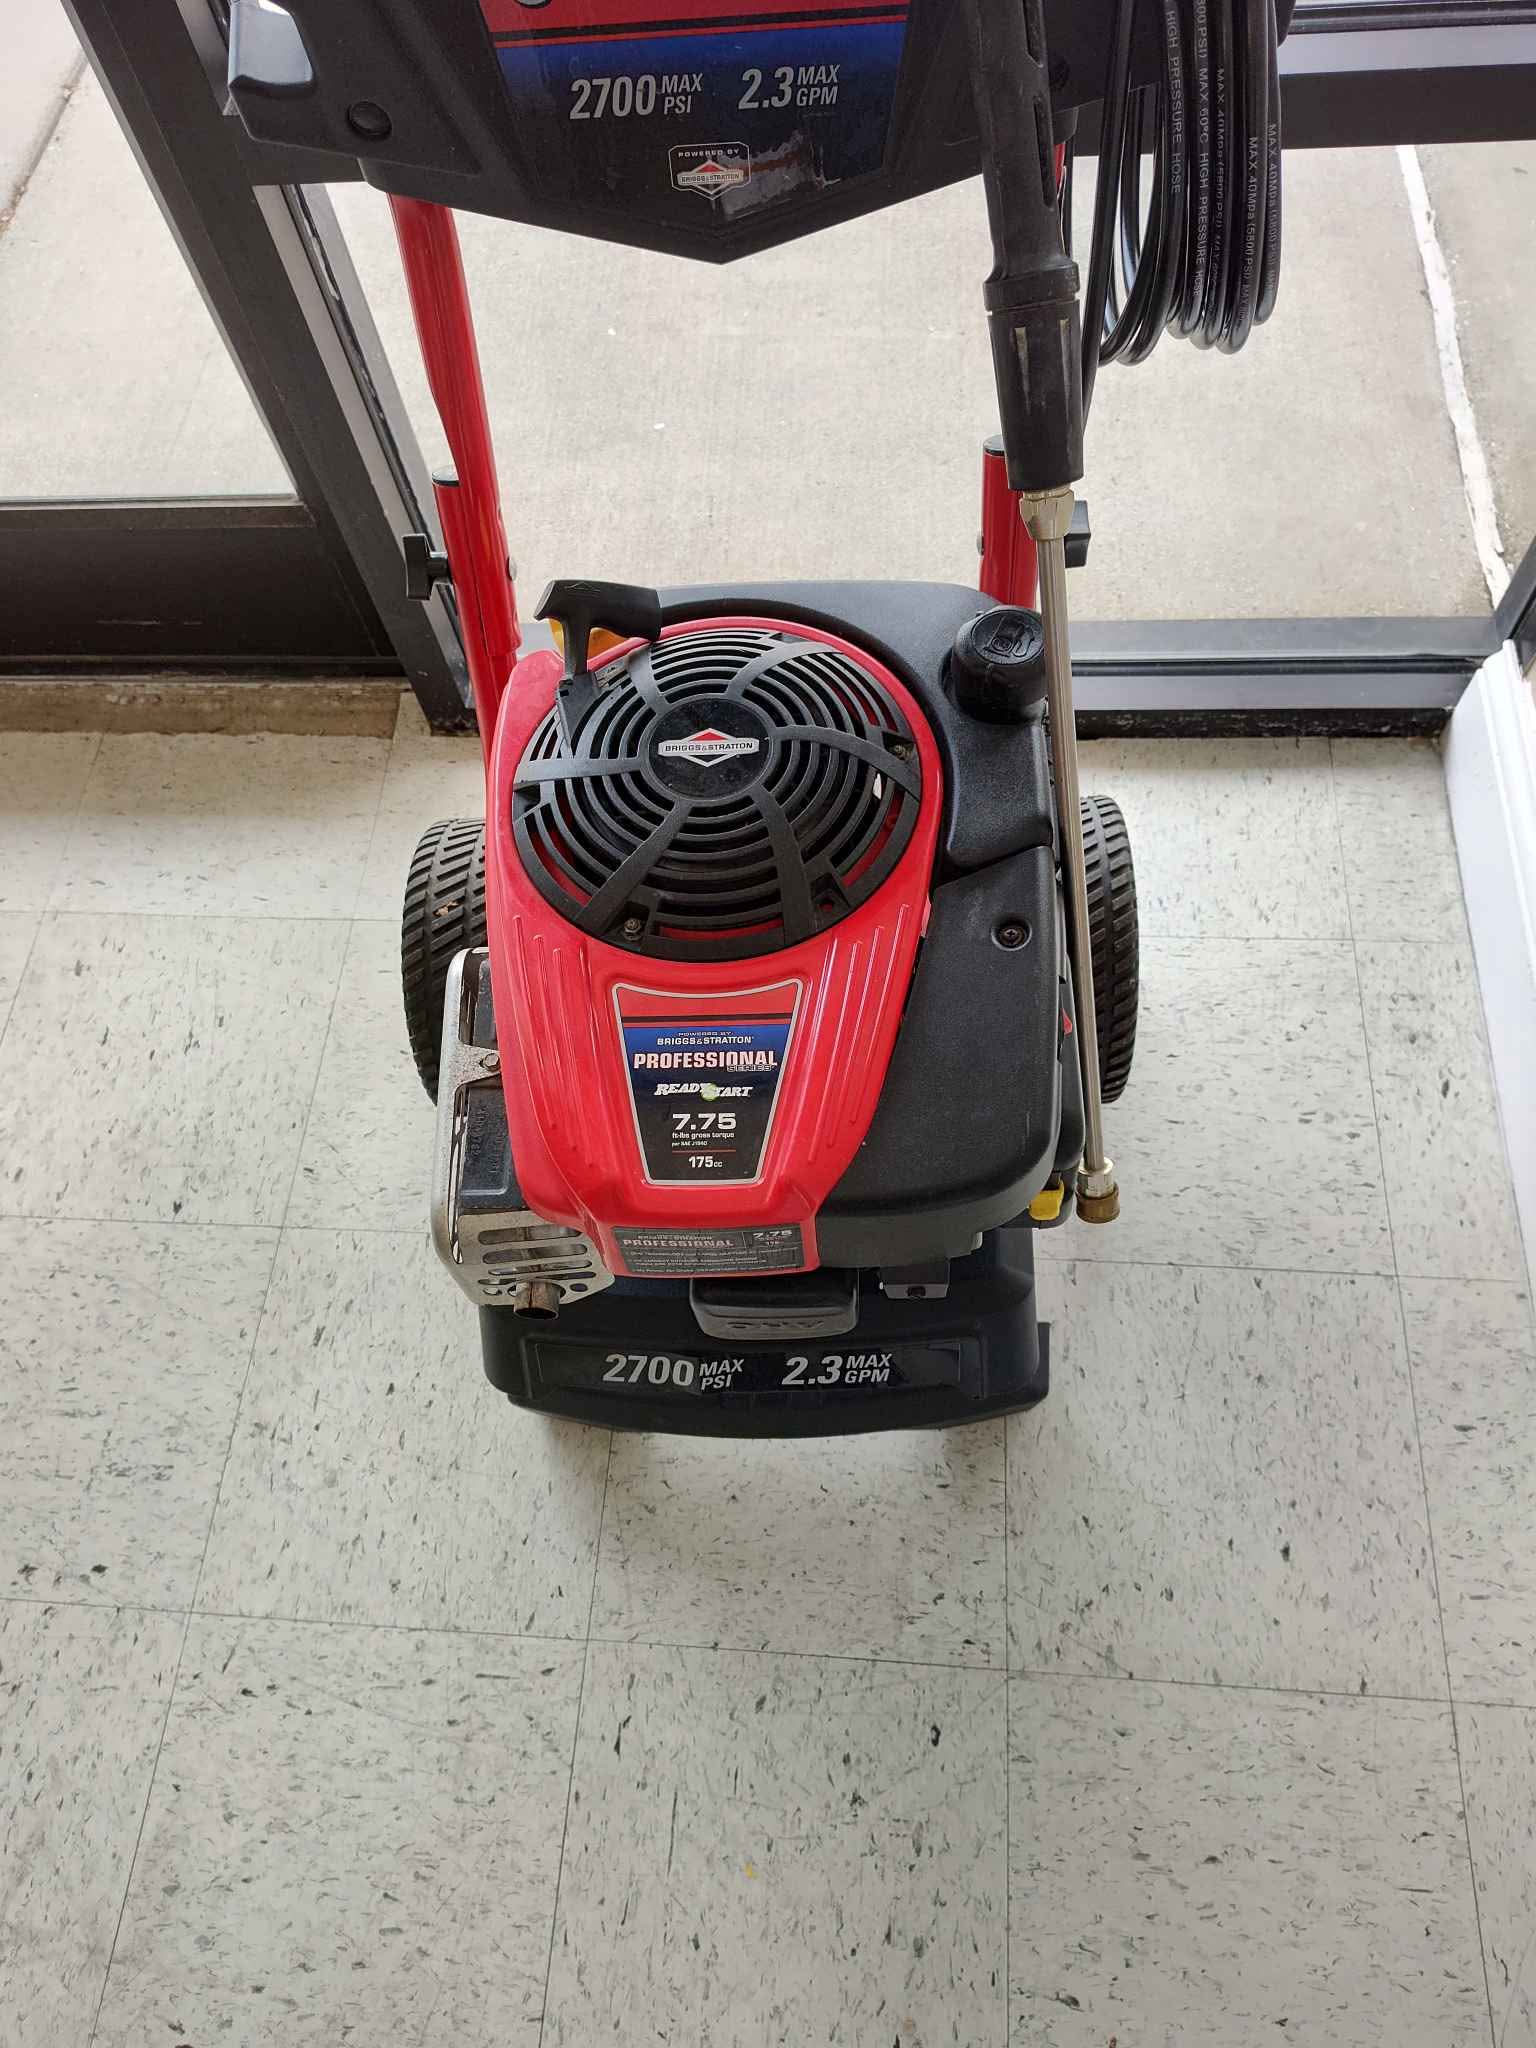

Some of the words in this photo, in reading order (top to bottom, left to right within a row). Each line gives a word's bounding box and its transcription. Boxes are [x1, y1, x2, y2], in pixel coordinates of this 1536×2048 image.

[1165, 10, 1178, 48] HIGH
[569, 75, 657, 120] 2700
[661, 73, 704, 94] MAX
[738, 66, 795, 110] 2.3
[797, 64, 841, 85] MAX
[796, 86, 839, 107] GPM
[1170, 56, 1183, 144] PRESSURE
[1199, 67, 1209, 102] MAX
[1216, 67, 1225, 103] MAX
[663, 95, 693, 115] PSI
[678, 149, 724, 158] POWERED
[1248, 136, 1258, 169] MAX
[1266, 123, 1278, 158] MAX
[1171, 152, 1182, 193] HOSE
[1199, 152, 1209, 189] HIGH
[1195, 196, 1209, 265] PRESSURE
[1192, 271, 1205, 297] HOSE
[633, 1050, 778, 1069] PROFESSIONAL
[672, 1112, 737, 1131] 7.75
[691, 1132, 711, 1140] gross
[711, 1131, 735, 1139] torque
[623, 1238, 735, 1248] PROFESSIONAL
[602, 1353, 695, 1387] 2700
[700, 1358, 745, 1378] MAX
[701, 1373, 732, 1391] PSI
[781, 1355, 843, 1386] 2.3
[845, 1353, 893, 1369] MAX
[844, 1368, 890, 1384] GPM
